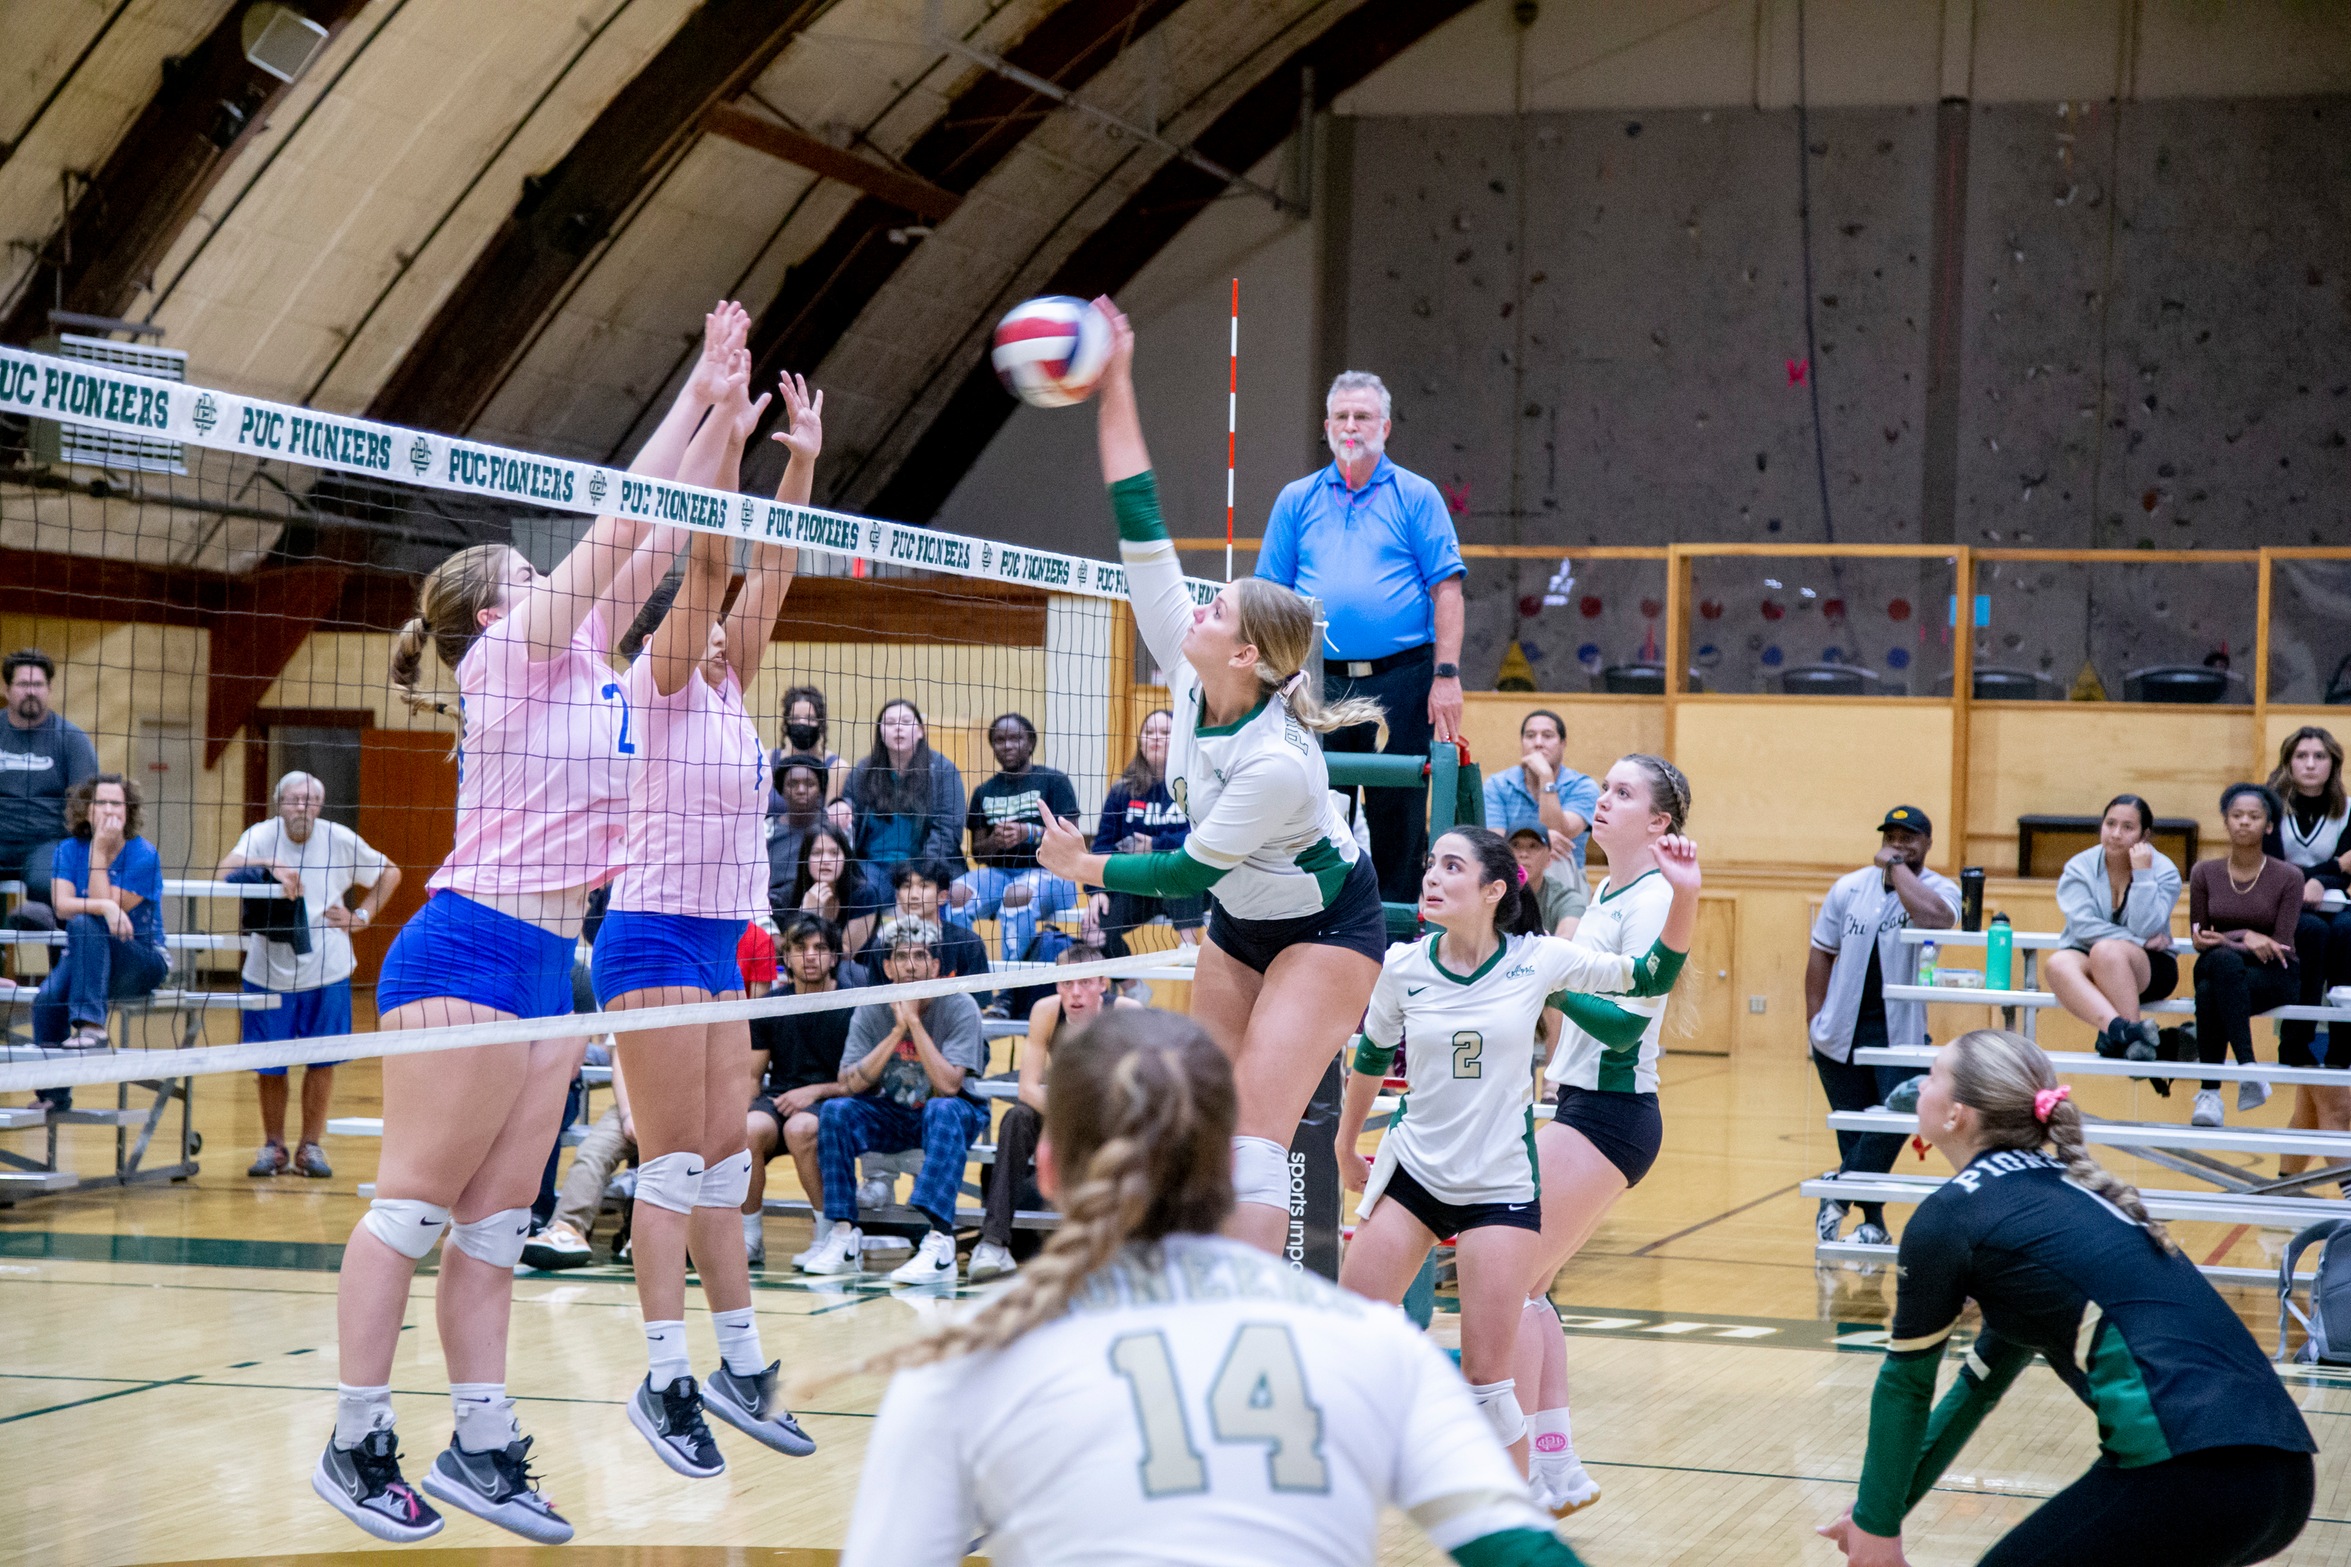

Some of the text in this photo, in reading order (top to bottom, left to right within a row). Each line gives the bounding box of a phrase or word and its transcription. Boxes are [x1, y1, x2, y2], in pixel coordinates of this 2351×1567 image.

[42, 367, 169, 430] PIONEERS
[238, 406, 284, 450] PUC
[288, 416, 391, 471] PIONEERS
[448, 448, 487, 487] PUC
[489, 455, 574, 502] PIONEERS
[620, 480, 652, 515] PUC
[655, 486, 728, 529] PIONEERS
[766, 507, 793, 539] PUC
[796, 512, 859, 550] PIONEERS
[890, 530, 916, 560] PUC
[916, 535, 971, 570] PIONEERS
[1096, 567, 1115, 592] PUC
[601, 683, 635, 755] 2
[1125, 799, 1187, 826] FILA
[1842, 912, 1911, 937] Chicag
[1452, 1031, 1483, 1079] 2
[1286, 1152, 1307, 1273] sports impo
[1107, 1320, 1331, 1499] 14
